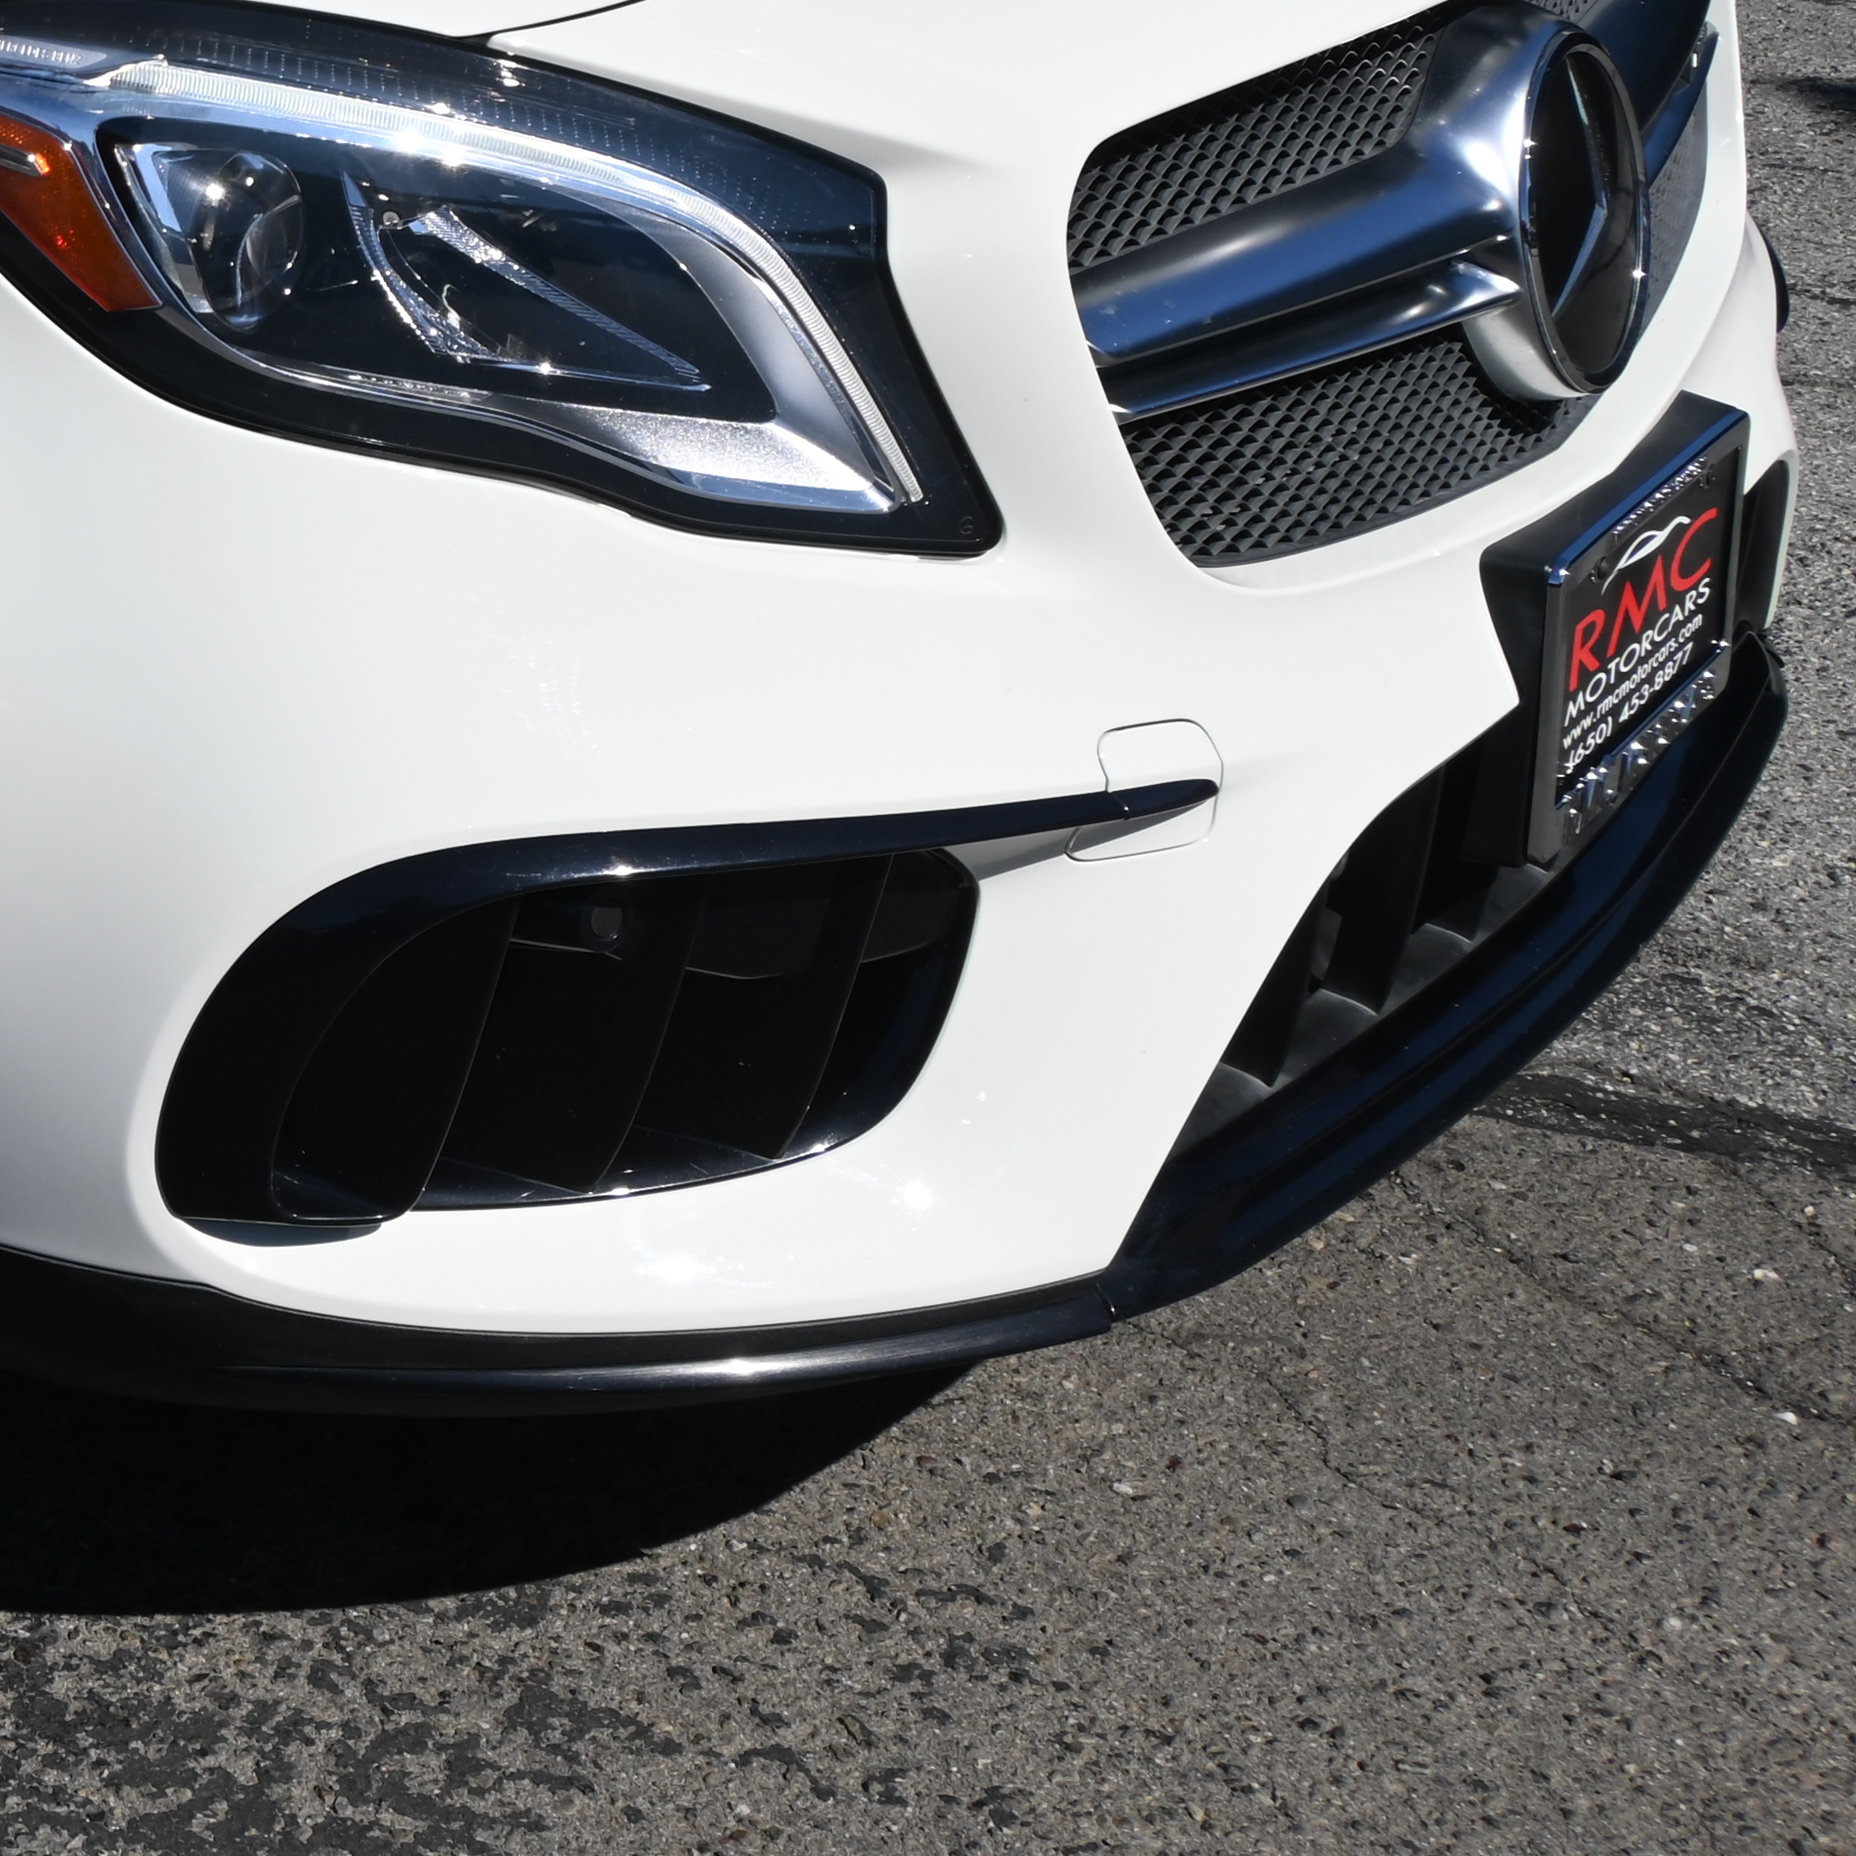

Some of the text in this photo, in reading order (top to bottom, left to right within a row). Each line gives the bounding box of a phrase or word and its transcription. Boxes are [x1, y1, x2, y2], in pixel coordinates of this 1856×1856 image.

[1564, 577, 1712, 727] MOTORCARS
[1569, 506, 1719, 692] RMC
[1562, 613, 1704, 750] www.rmcmotorcars.com
[1565, 716, 1613, 774] (650)
[1617, 640, 1694, 724] 453-8877
